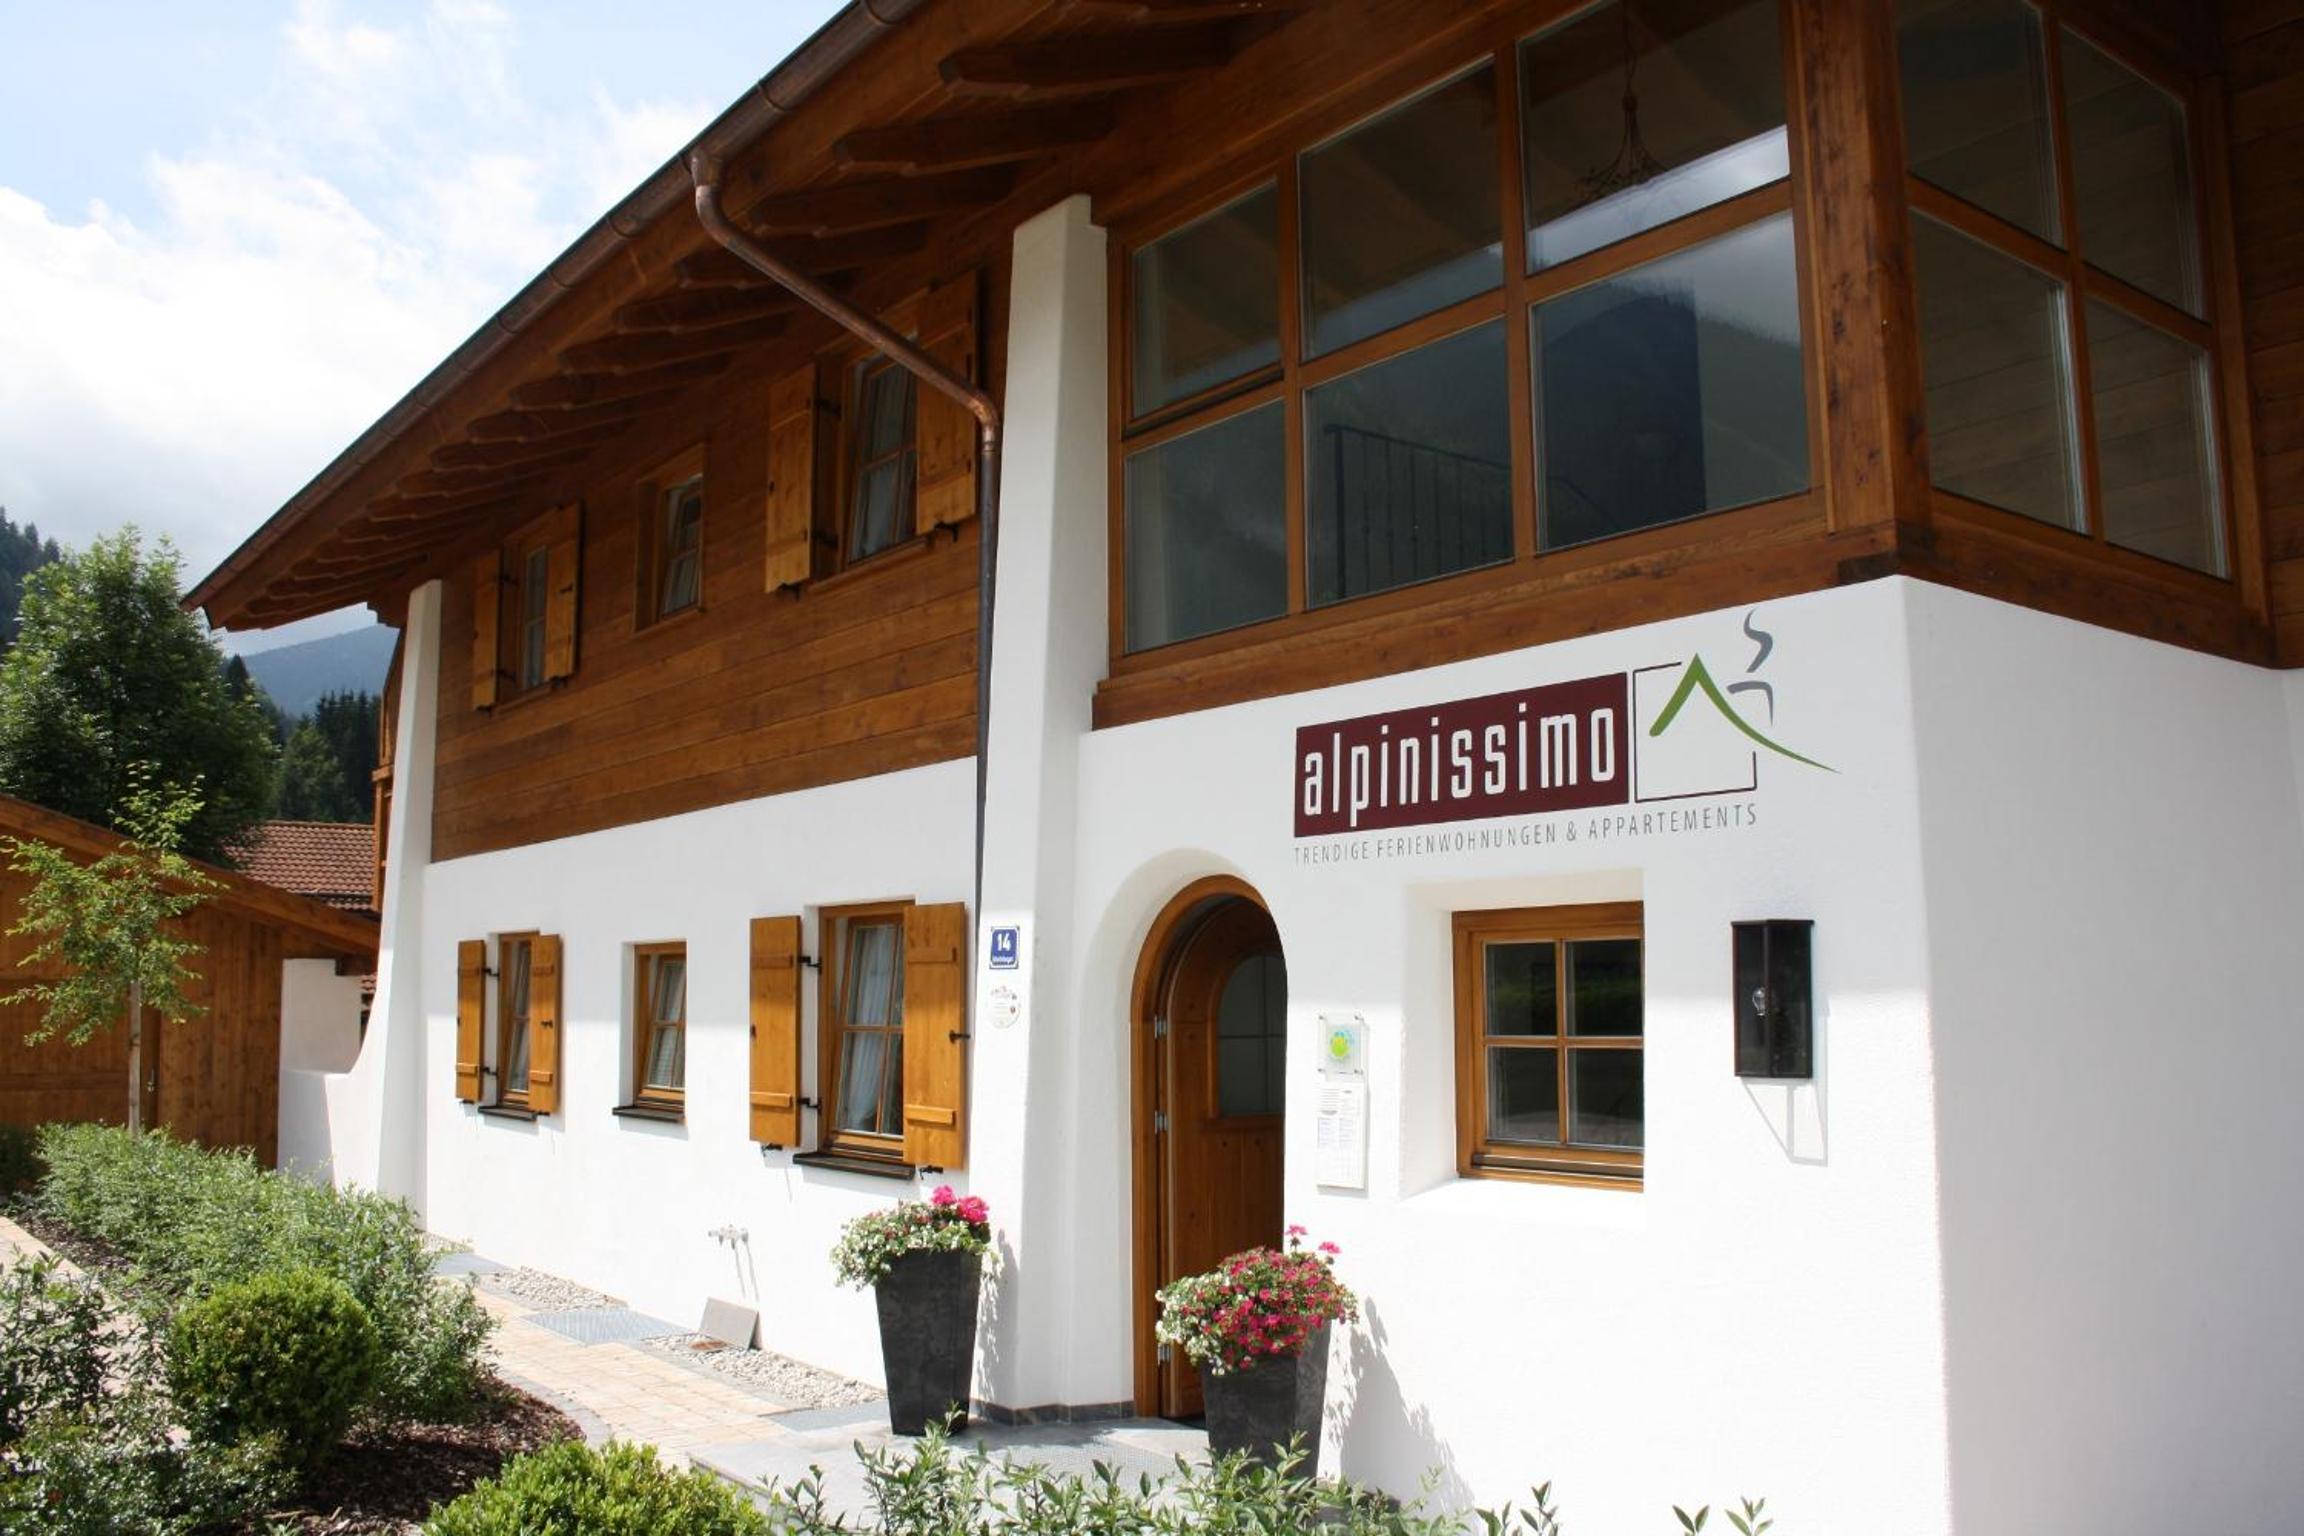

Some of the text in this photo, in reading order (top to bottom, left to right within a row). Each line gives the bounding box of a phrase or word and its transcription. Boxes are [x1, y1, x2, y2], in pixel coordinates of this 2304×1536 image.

[1304, 703, 1615, 826] alpinissimo
[1294, 804, 1758, 865] TRENDIGE FERIENWOHNUNGEN & APPARTEMENTS
[997, 933, 1011, 951] 14
